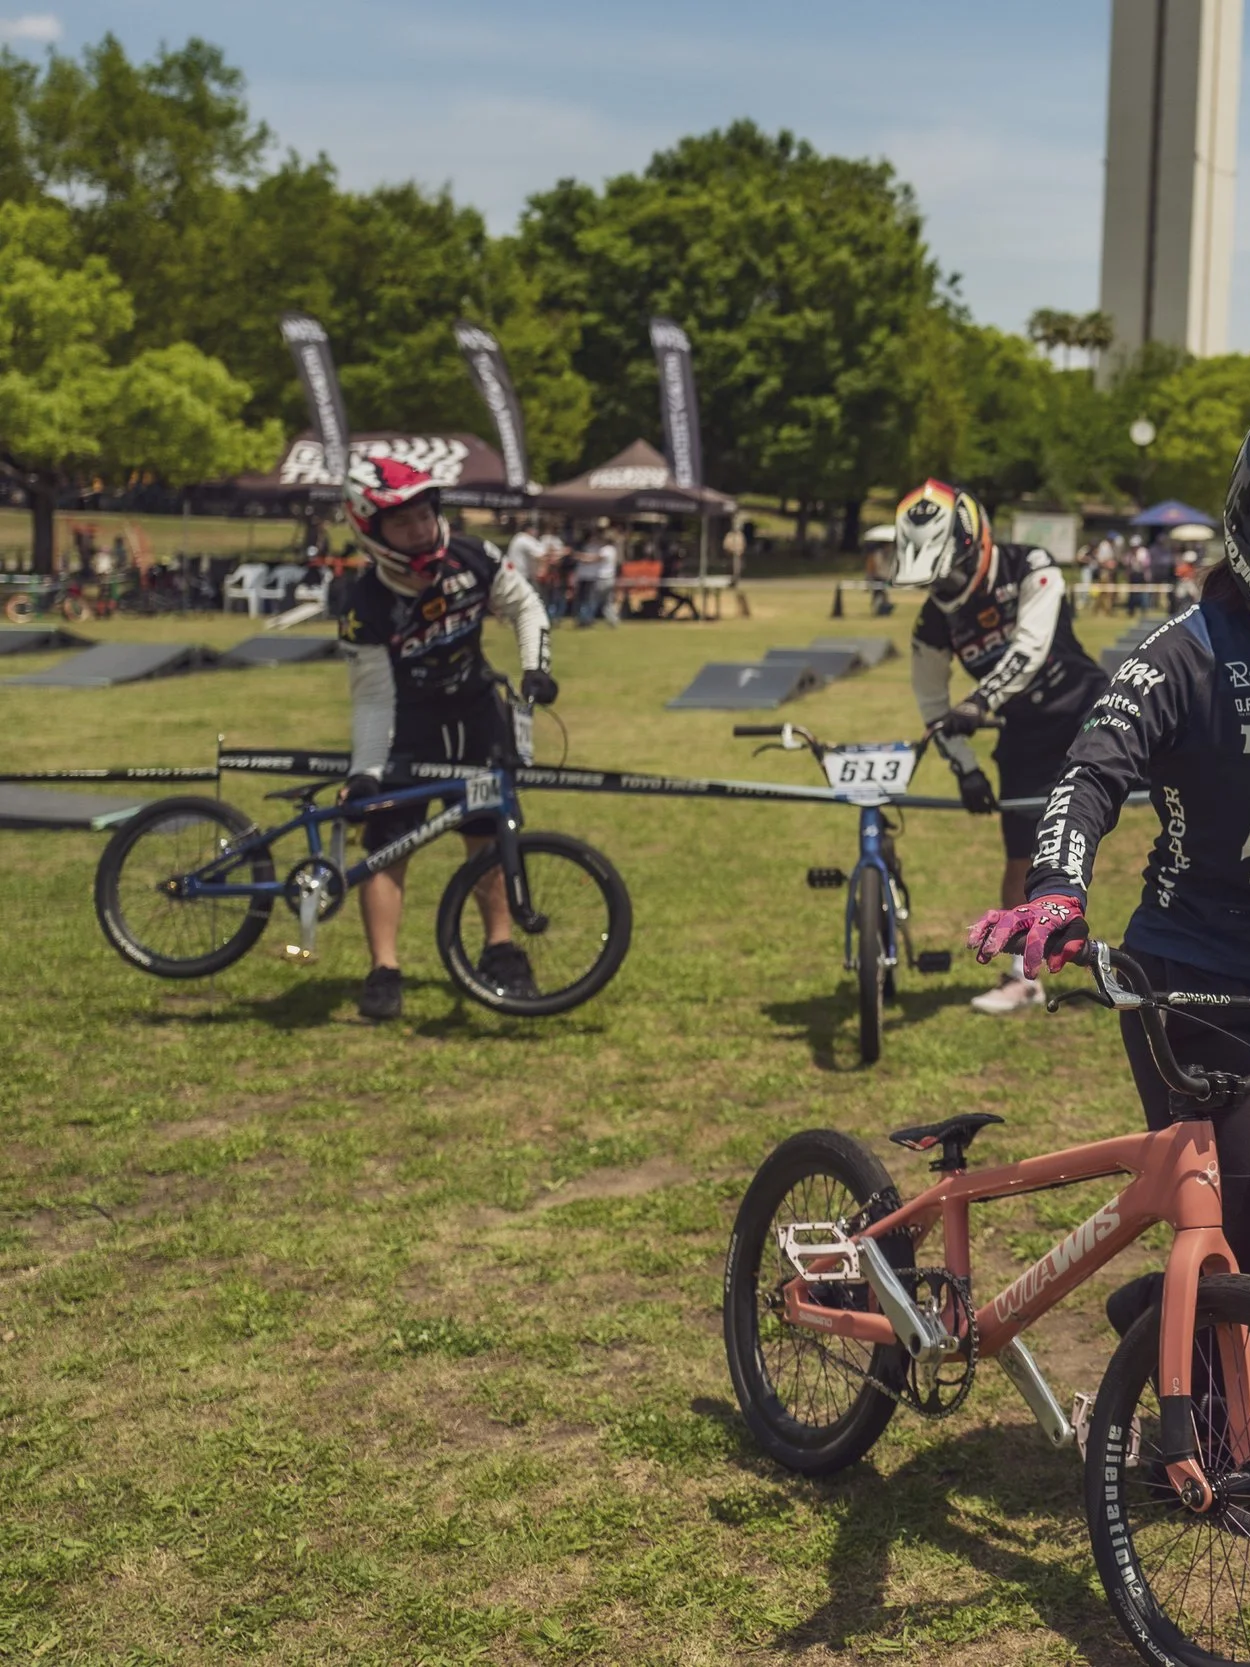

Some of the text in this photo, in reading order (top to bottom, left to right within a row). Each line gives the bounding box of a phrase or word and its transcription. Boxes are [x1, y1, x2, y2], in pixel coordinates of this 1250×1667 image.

[515, 769, 556, 784] TOYO
[620, 774, 662, 789] TOYO
[994, 1195, 1121, 1324] WIAWIS
[1104, 1423, 1139, 1587] alienation
[1147, 1640, 1176, 1667] ASTR
